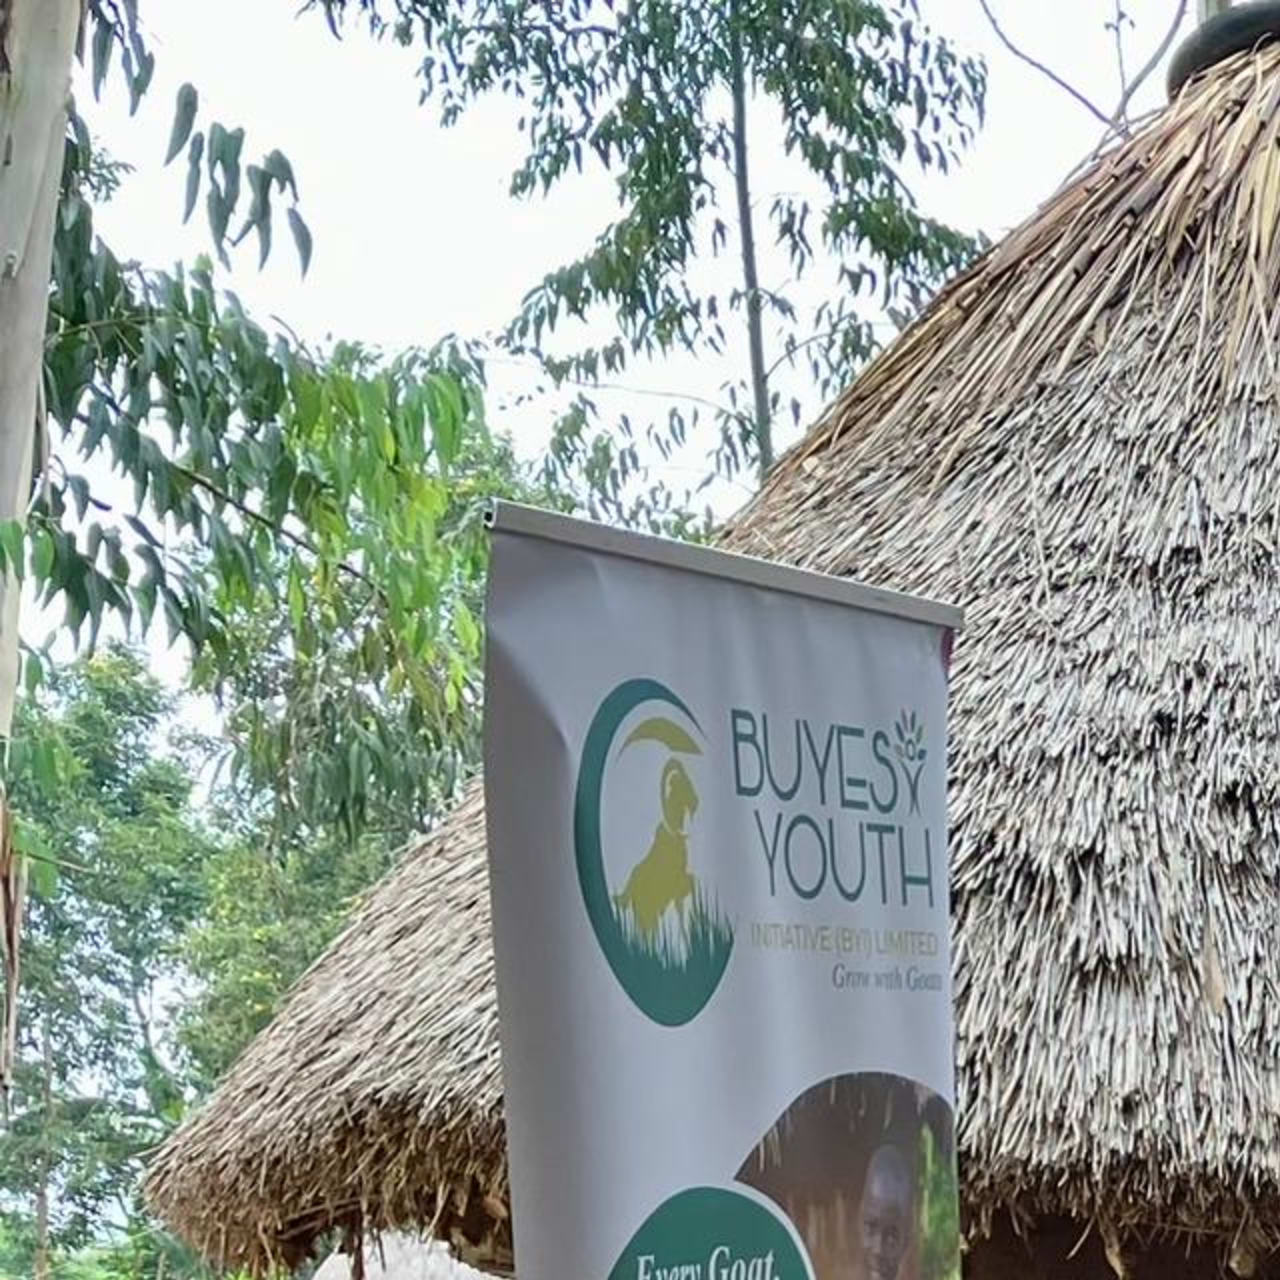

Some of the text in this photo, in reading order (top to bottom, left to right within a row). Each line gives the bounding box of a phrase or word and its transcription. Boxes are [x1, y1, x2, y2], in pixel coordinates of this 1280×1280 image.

[754, 809, 935, 908] YOUTH
[751, 923, 832, 953] INITIATIVE
[876, 928, 939, 956] LIMITED
